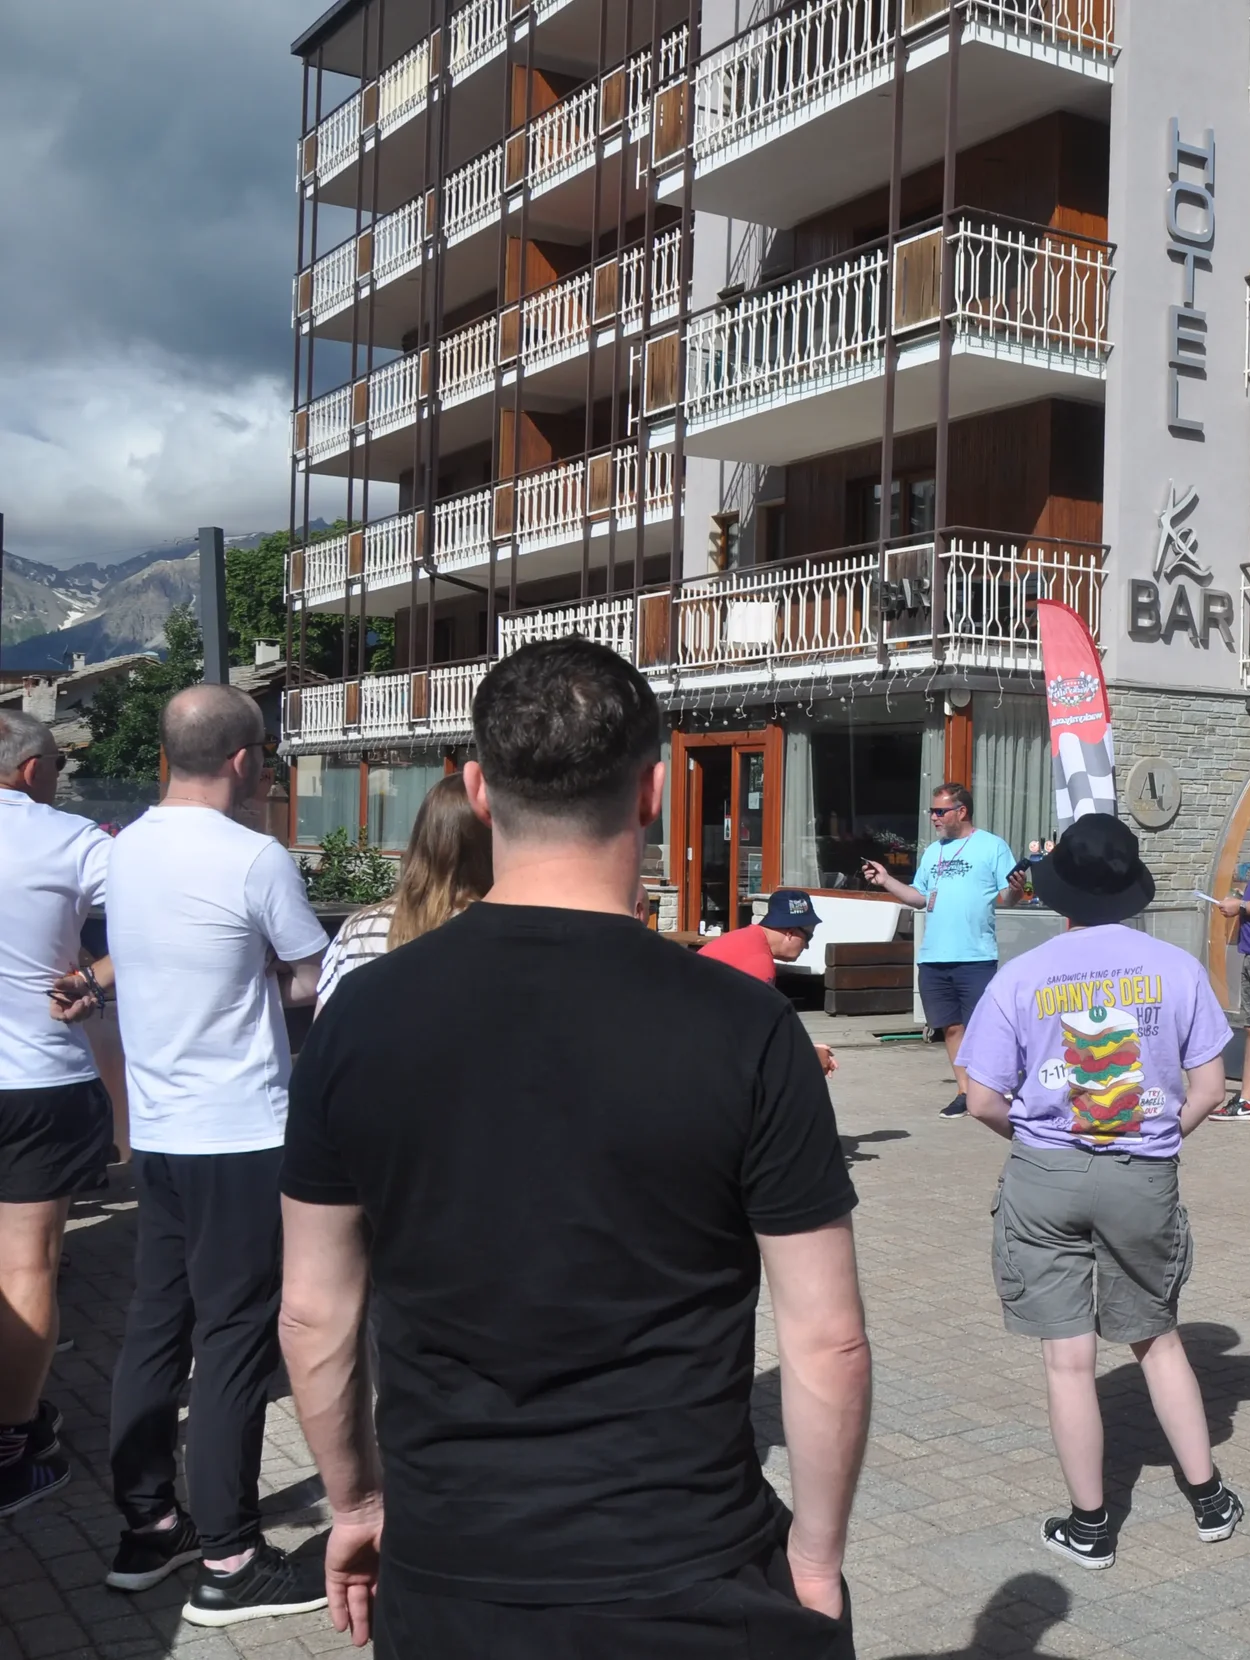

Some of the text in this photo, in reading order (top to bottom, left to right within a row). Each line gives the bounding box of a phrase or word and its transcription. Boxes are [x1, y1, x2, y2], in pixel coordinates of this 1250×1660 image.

[1166, 114, 1215, 441] HOTEL
[1127, 578, 1236, 653] BAR
[1046, 965, 1144, 985] SANDWICH KING OF NYC!
[1035, 975, 1163, 1020] JOHNY'S DELI
[1136, 1006, 1161, 1025] HOT
[1041, 1064, 1066, 1083] 7-11
[1140, 1096, 1165, 1106] BAGELS
